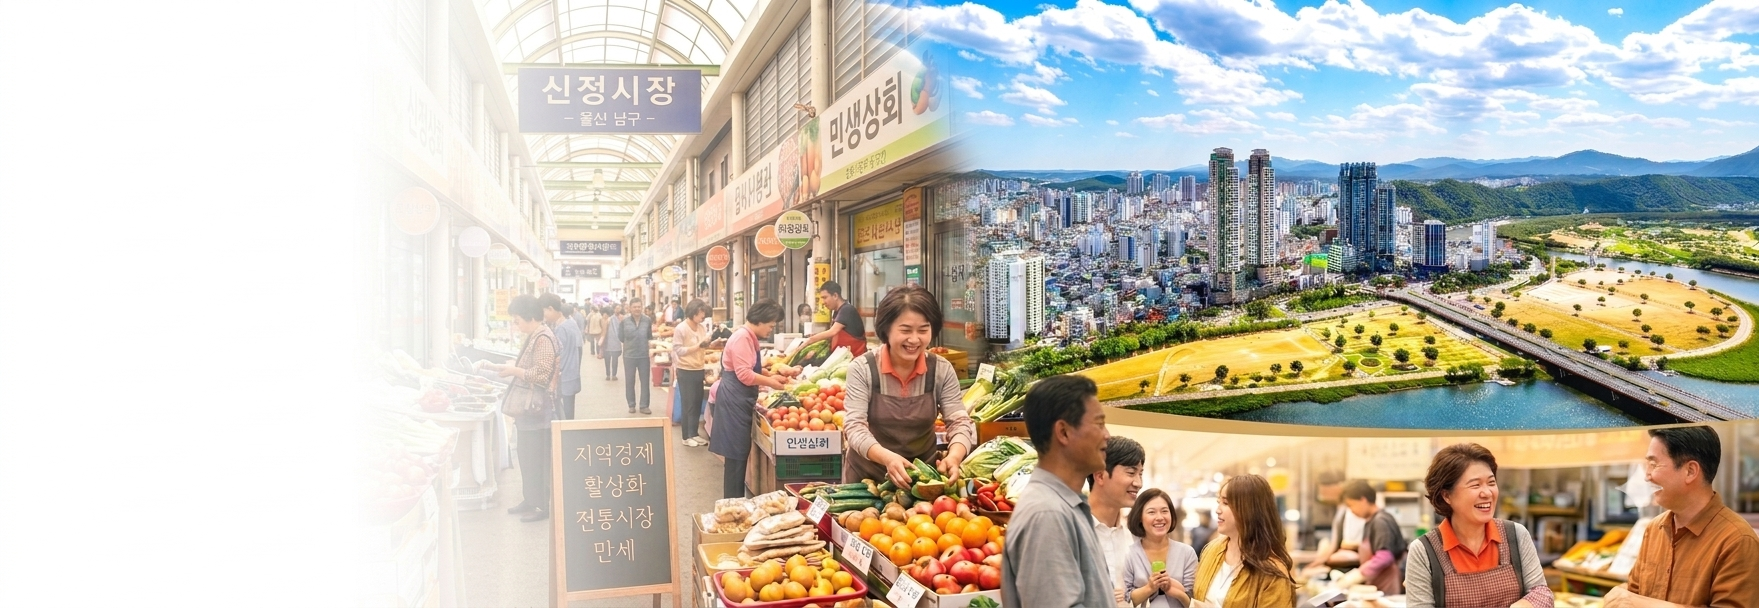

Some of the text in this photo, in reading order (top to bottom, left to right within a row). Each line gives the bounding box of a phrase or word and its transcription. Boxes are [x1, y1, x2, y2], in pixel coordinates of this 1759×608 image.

[541, 74, 676, 106] 신정시장
[614, 111, 641, 127] 남구
[829, 70, 903, 160] 민생상회
[574, 442, 654, 467] 지역경제
[584, 473, 647, 498] 활상화
[576, 505, 655, 532] 전통시장
[593, 538, 636, 563] 만세
